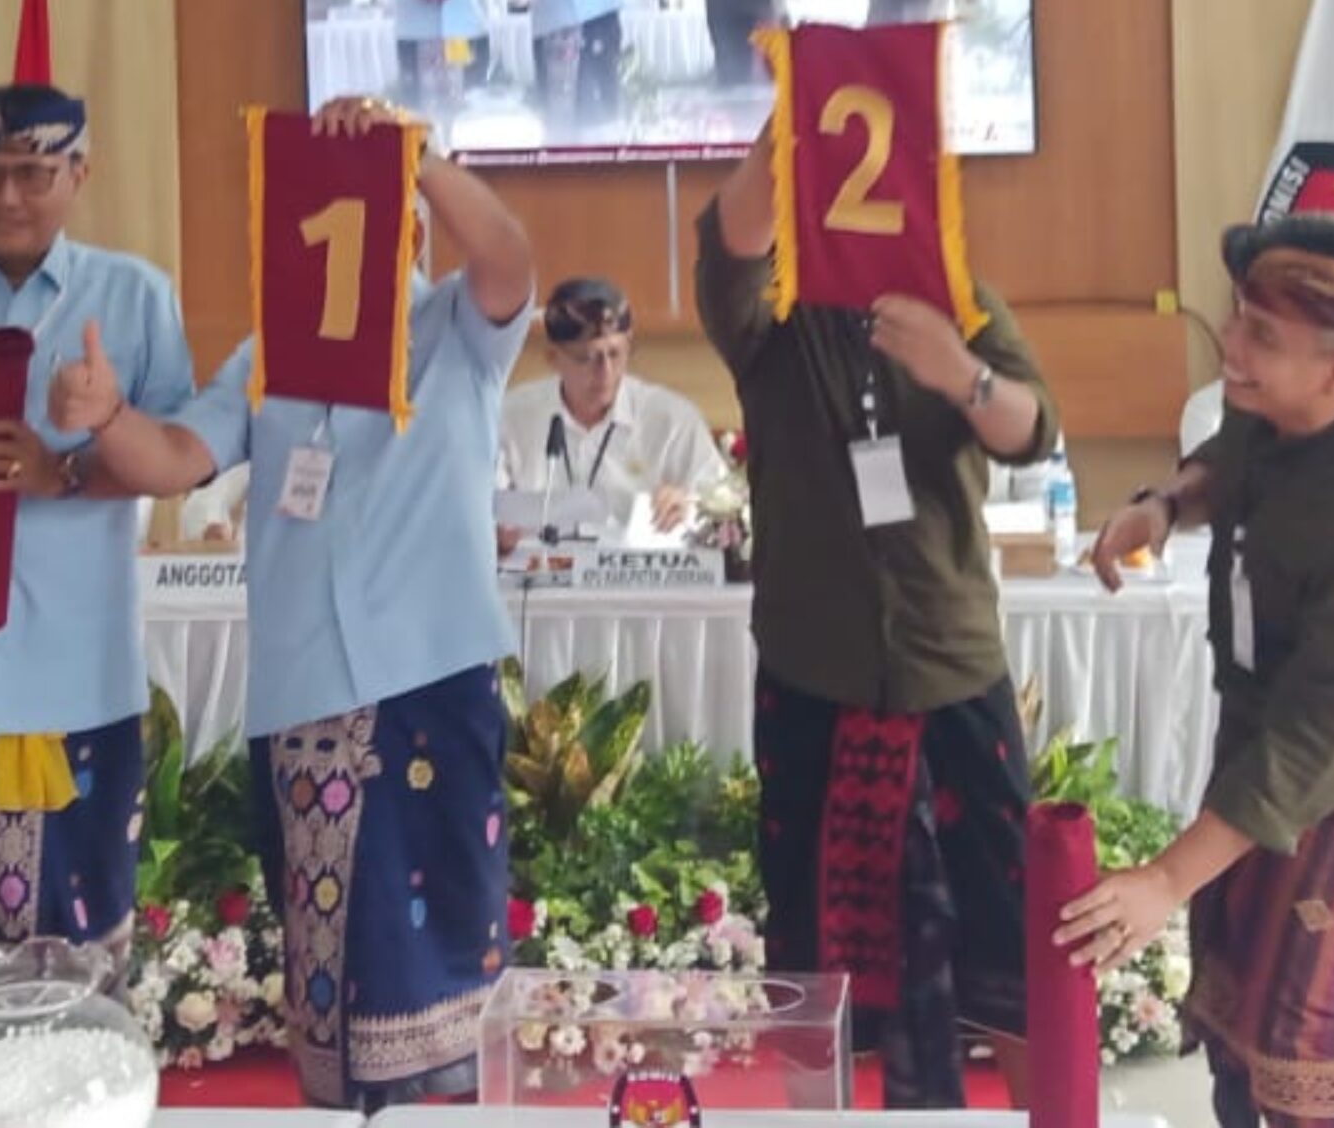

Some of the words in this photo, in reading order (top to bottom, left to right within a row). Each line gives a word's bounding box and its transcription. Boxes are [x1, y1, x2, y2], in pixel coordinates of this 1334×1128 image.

[818, 83, 906, 235] 2
[298, 198, 366, 341] 1
[156, 563, 247, 587] ANGGOTA
[598, 552, 700, 569] KETUA
